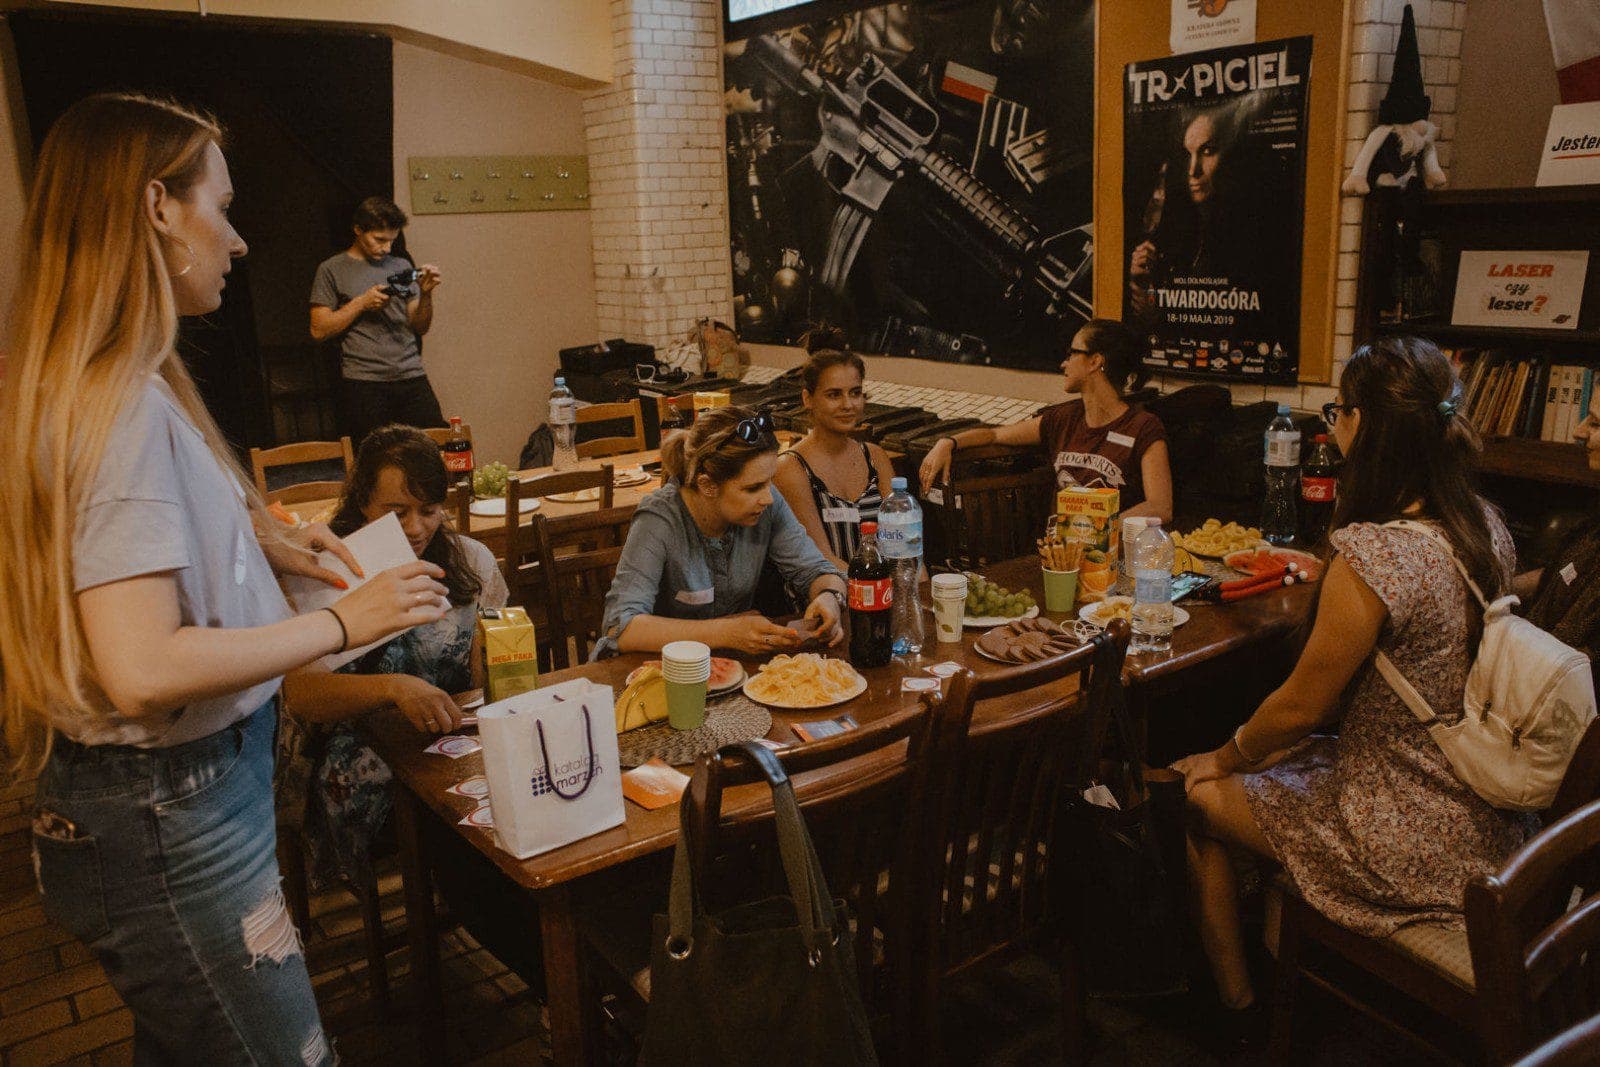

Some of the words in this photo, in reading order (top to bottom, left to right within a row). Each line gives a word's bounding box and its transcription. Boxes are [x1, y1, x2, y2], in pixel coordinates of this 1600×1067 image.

[1487, 264, 1554, 278] LASER
[1505, 283, 1530, 296] czy
[1157, 287, 1260, 311] TWARDOGÓRA
[1488, 295, 1548, 314] leser?
[1167, 313, 1188, 323] 18-19
[1189, 314, 1212, 324] MAJA
[1213, 315, 1235, 326] 2019
